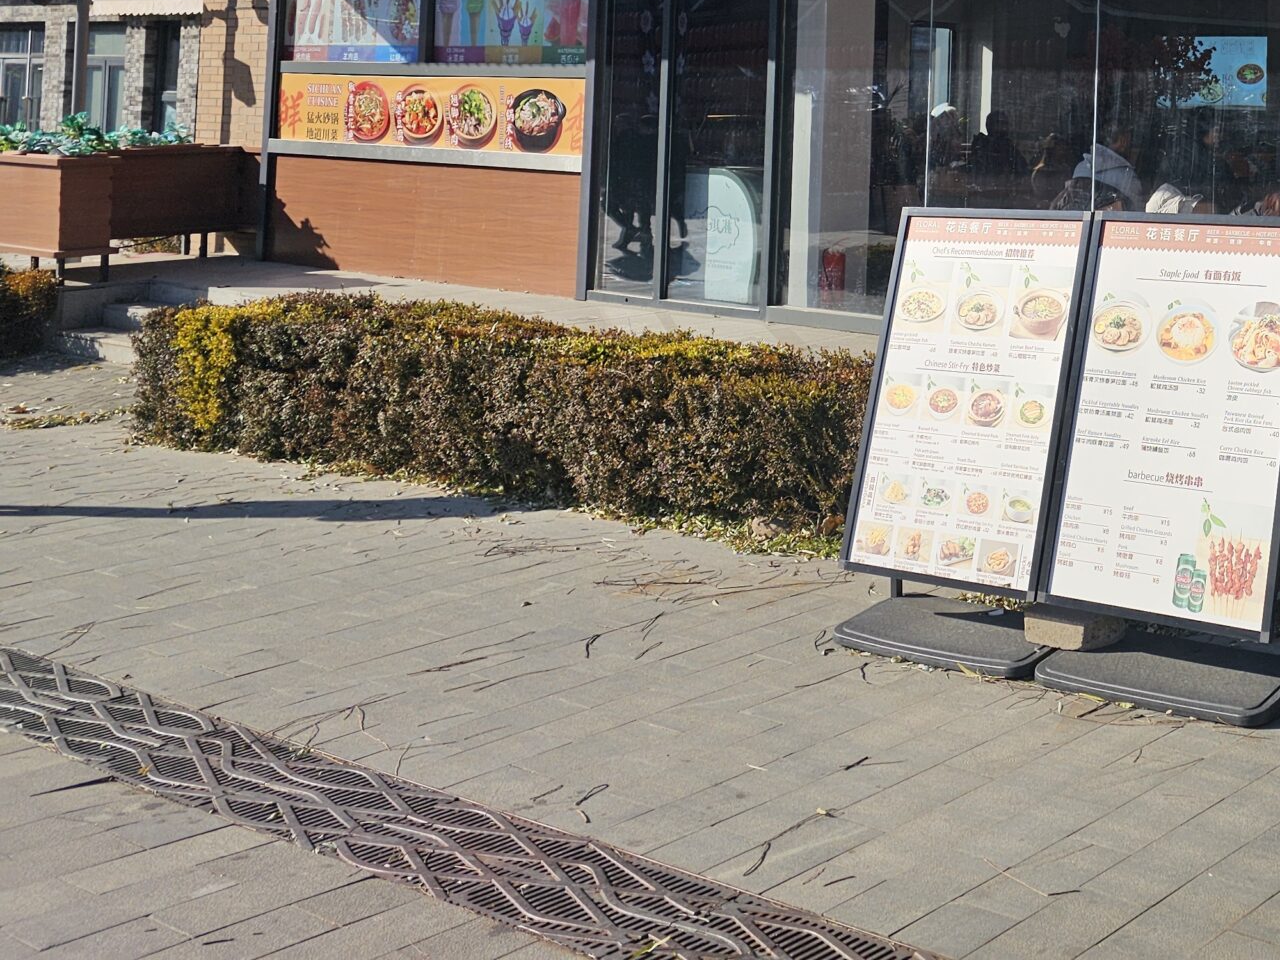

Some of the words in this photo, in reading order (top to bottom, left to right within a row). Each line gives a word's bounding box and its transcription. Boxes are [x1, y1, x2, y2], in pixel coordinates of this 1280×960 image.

[306, 83, 342, 95] SICHUAN
[306, 96, 339, 107] CUISINE
[306, 112, 339, 125] 猛火砂锅
[306, 127, 338, 141] 地道川菜
[945, 221, 992, 235] 花语餐厅
[1111, 226, 1141, 235] FLORAL
[1145, 227, 1201, 242] 花语餐厅
[932, 246, 950, 256] Chef's
[951, 247, 1003, 257] Recommendation
[1159, 268, 1182, 279] Staple
[1182, 268, 1200, 280] food
[1204, 269, 1241, 282] 有面有饭
[924, 359, 947, 370] Chinese
[1128, 469, 1165, 483] barbecue
[1165, 471, 1204, 488] 烧烤串串
